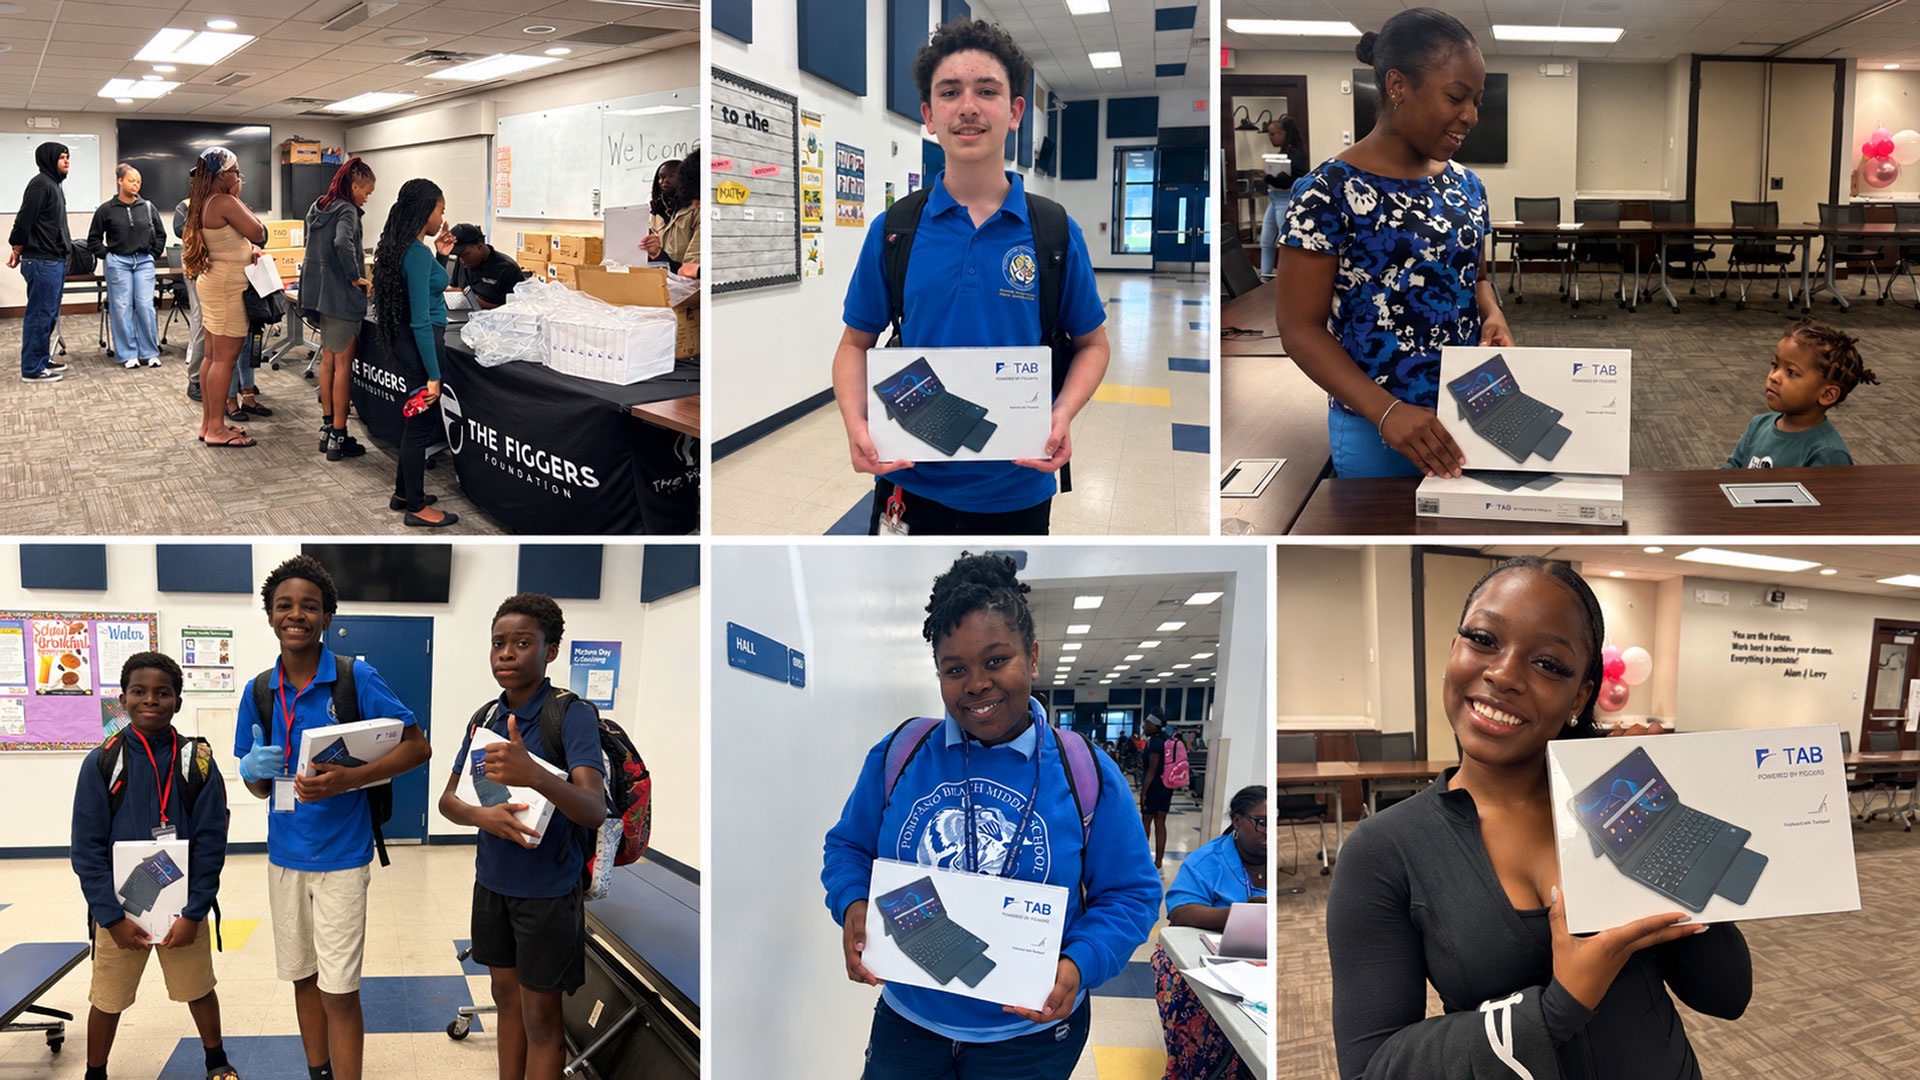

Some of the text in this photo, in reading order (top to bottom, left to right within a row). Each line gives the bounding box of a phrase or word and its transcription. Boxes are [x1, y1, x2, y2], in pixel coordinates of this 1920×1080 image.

[721, 105, 769, 133] to the
[607, 131, 700, 166] Welcome
[362, 361, 407, 394] FIGGERS
[1013, 362, 1039, 374] TAB
[1591, 363, 1617, 376] TAB
[467, 418, 600, 488] THE FIGGERS
[484, 452, 572, 499] FOUNDATION
[736, 636, 757, 656] HALL
[1784, 669, 1802, 677] Alan
[1809, 669, 1827, 679] Levy
[1782, 746, 1823, 765] TAB
[1024, 900, 1052, 916] TAB
